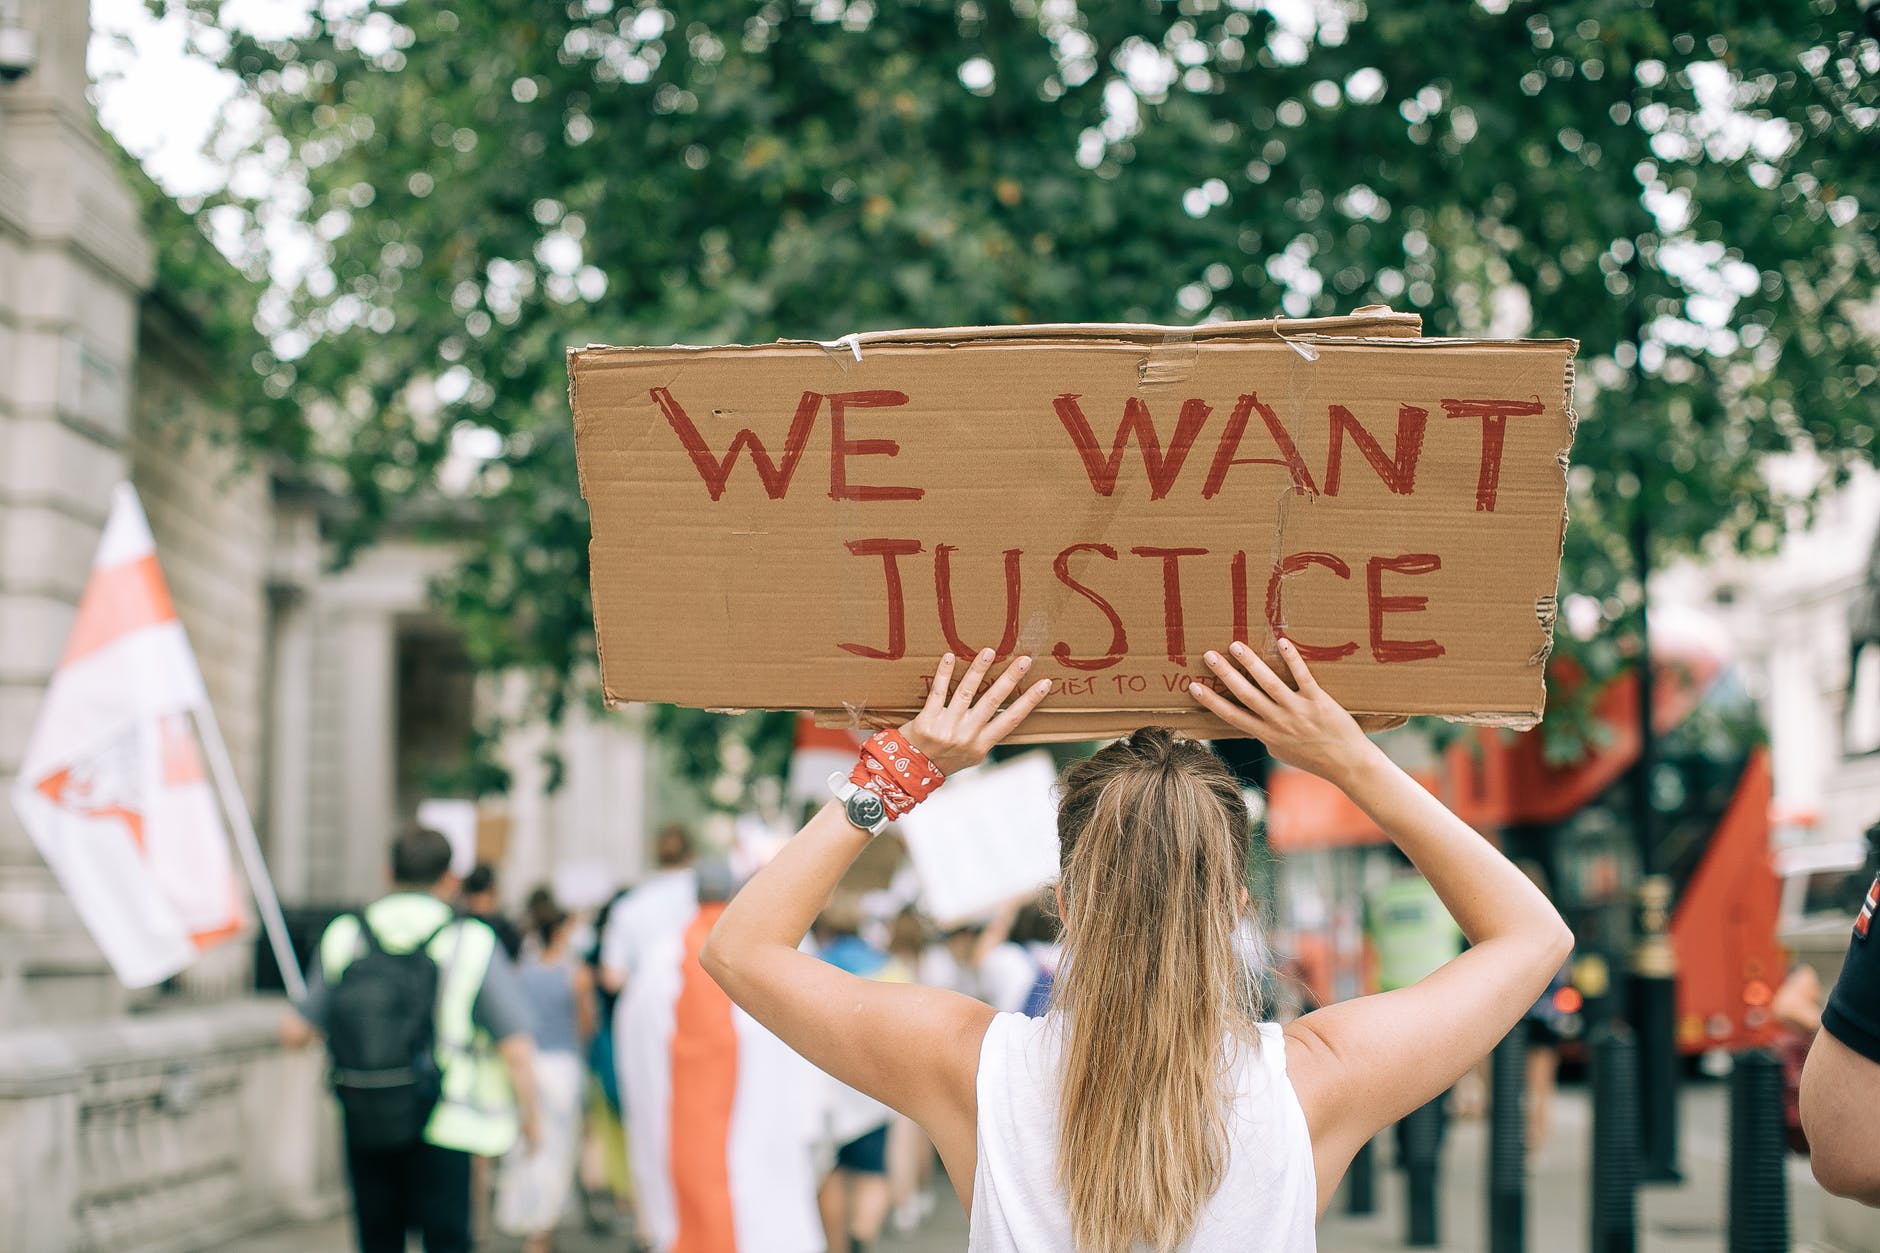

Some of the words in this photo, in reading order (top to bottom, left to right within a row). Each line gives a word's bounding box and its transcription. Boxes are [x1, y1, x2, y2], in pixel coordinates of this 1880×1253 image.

[650, 387, 925, 502] WE
[1052, 391, 1545, 512] WANT
[837, 538, 1446, 669] JUSTICE
[1112, 674, 1147, 694] TO
